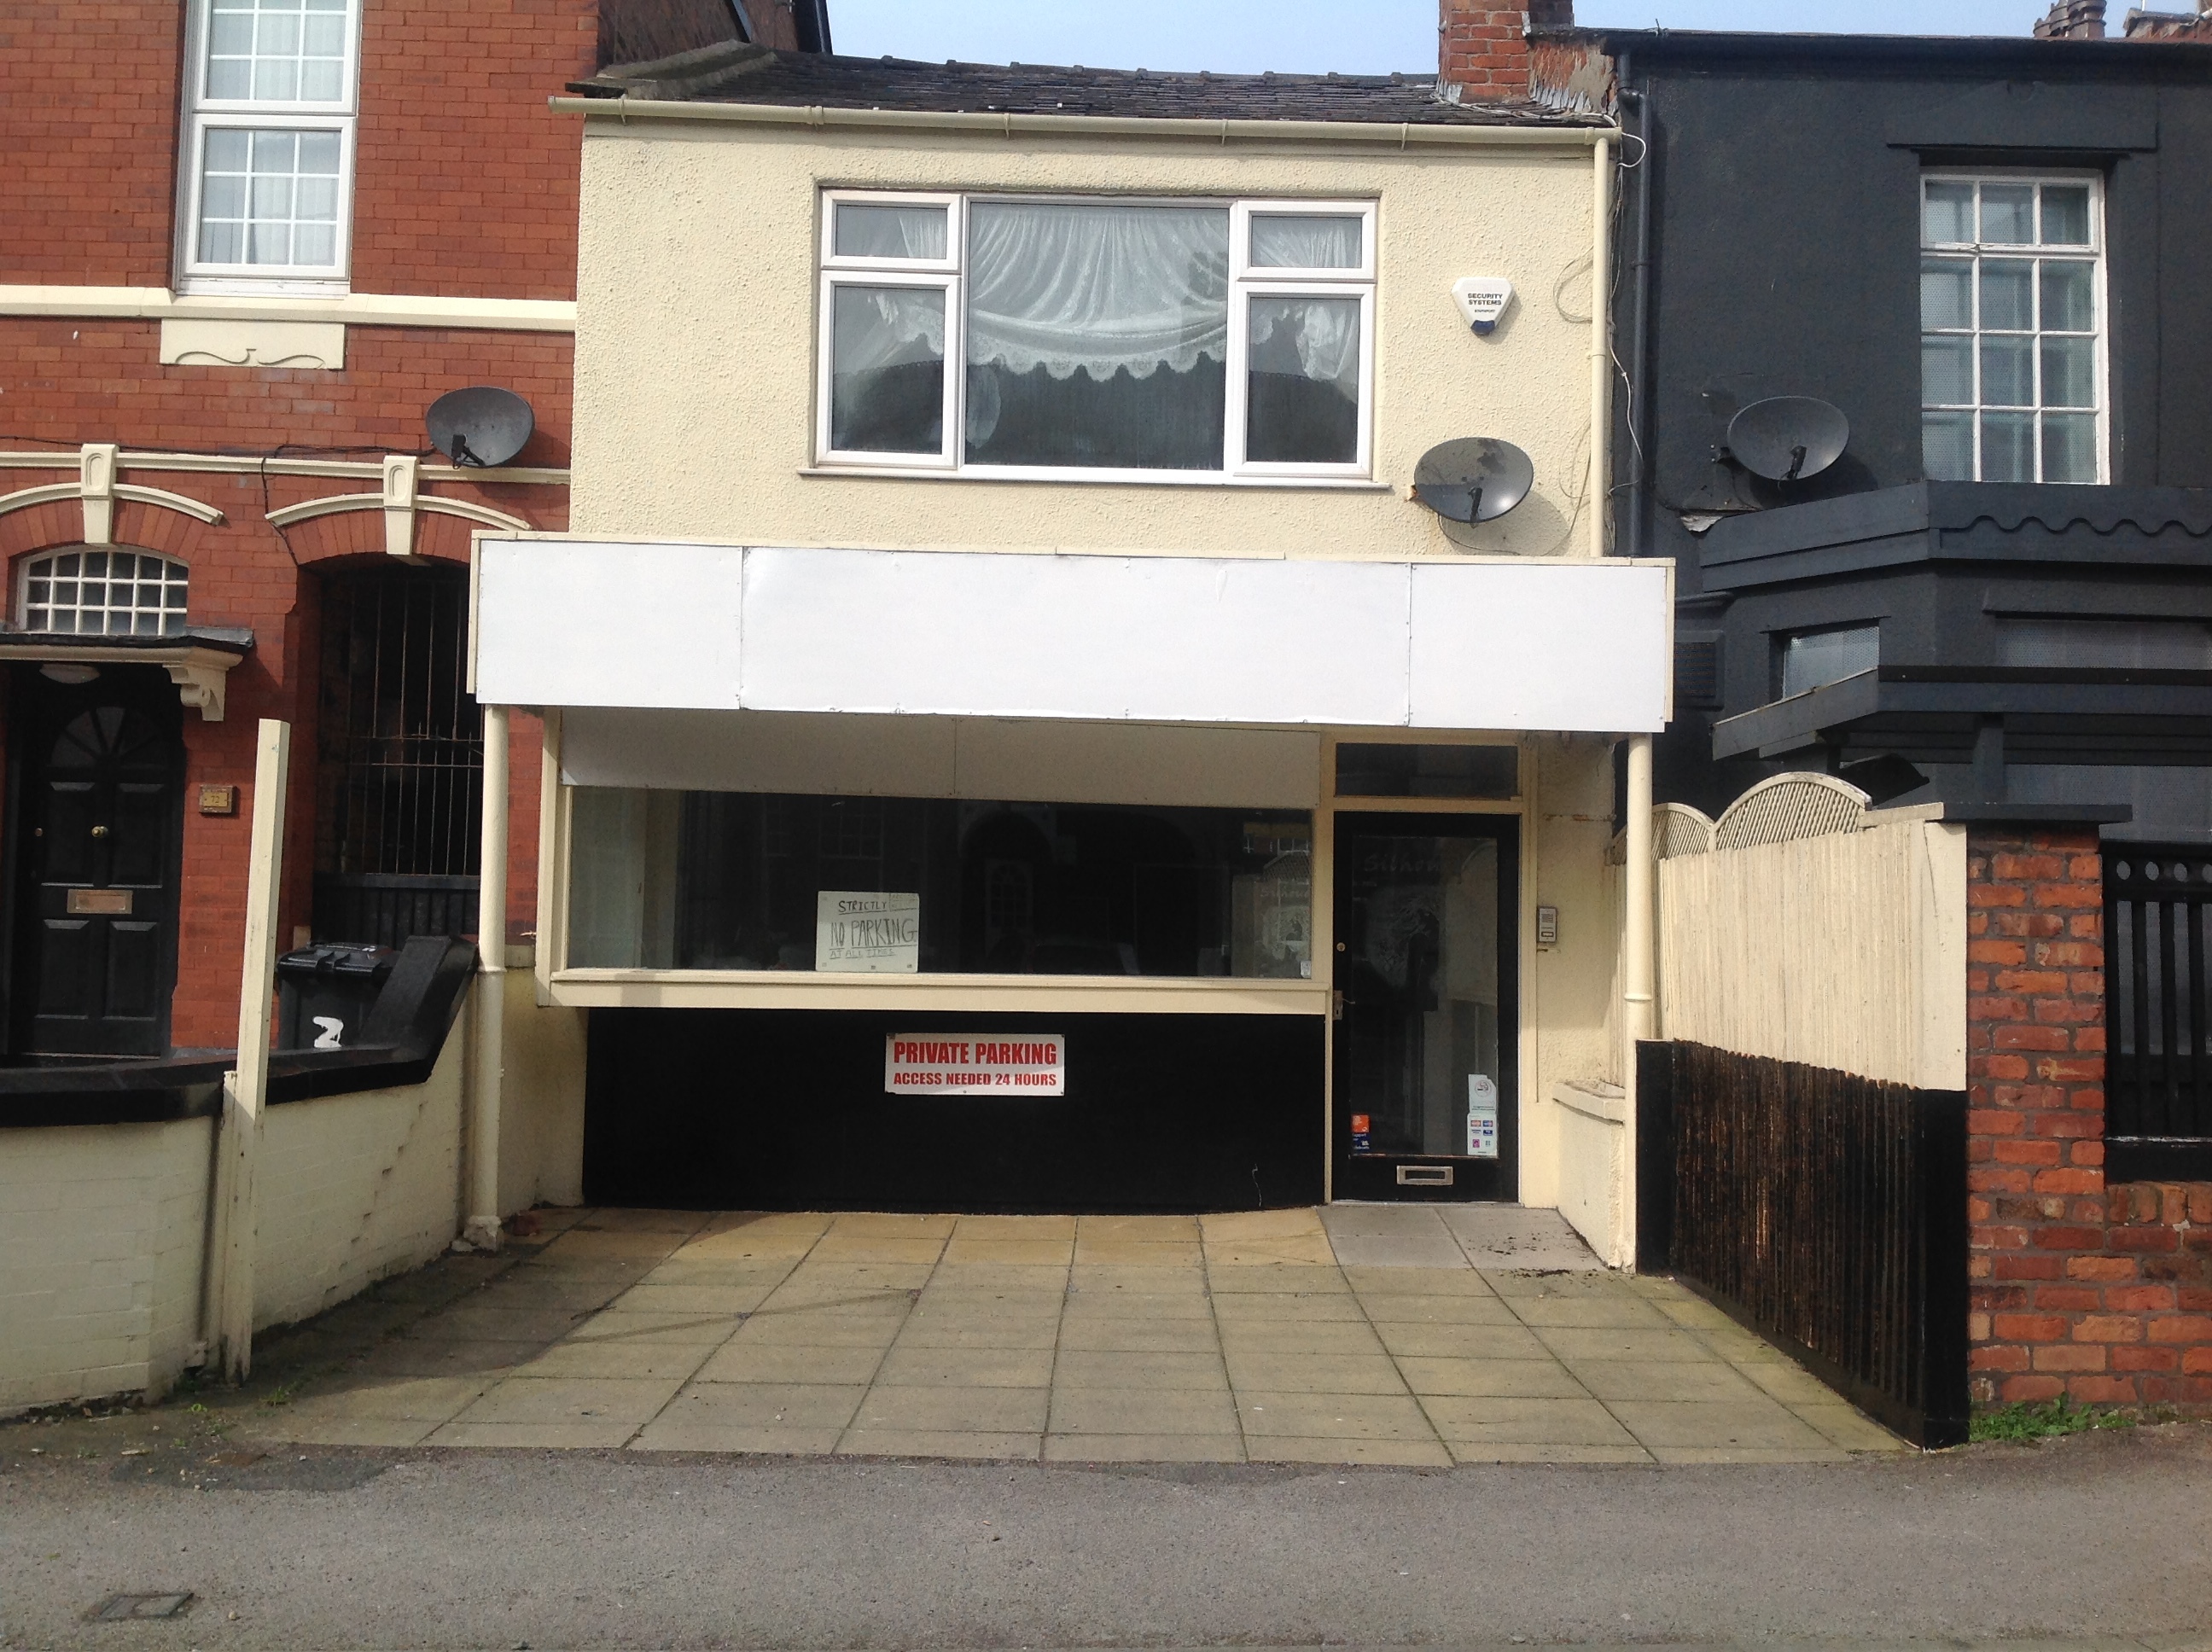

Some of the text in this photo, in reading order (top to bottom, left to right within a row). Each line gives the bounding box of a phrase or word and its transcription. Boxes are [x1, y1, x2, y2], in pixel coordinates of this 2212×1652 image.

[210, 795, 220, 804] 72
[838, 900, 888, 913] STRICTLY
[830, 918, 917, 947] NO PARKING
[894, 1041, 1057, 1065] PRIVATE PARKING
[894, 1073, 1057, 1085] ACCESS NEEDED 24 HOURS
